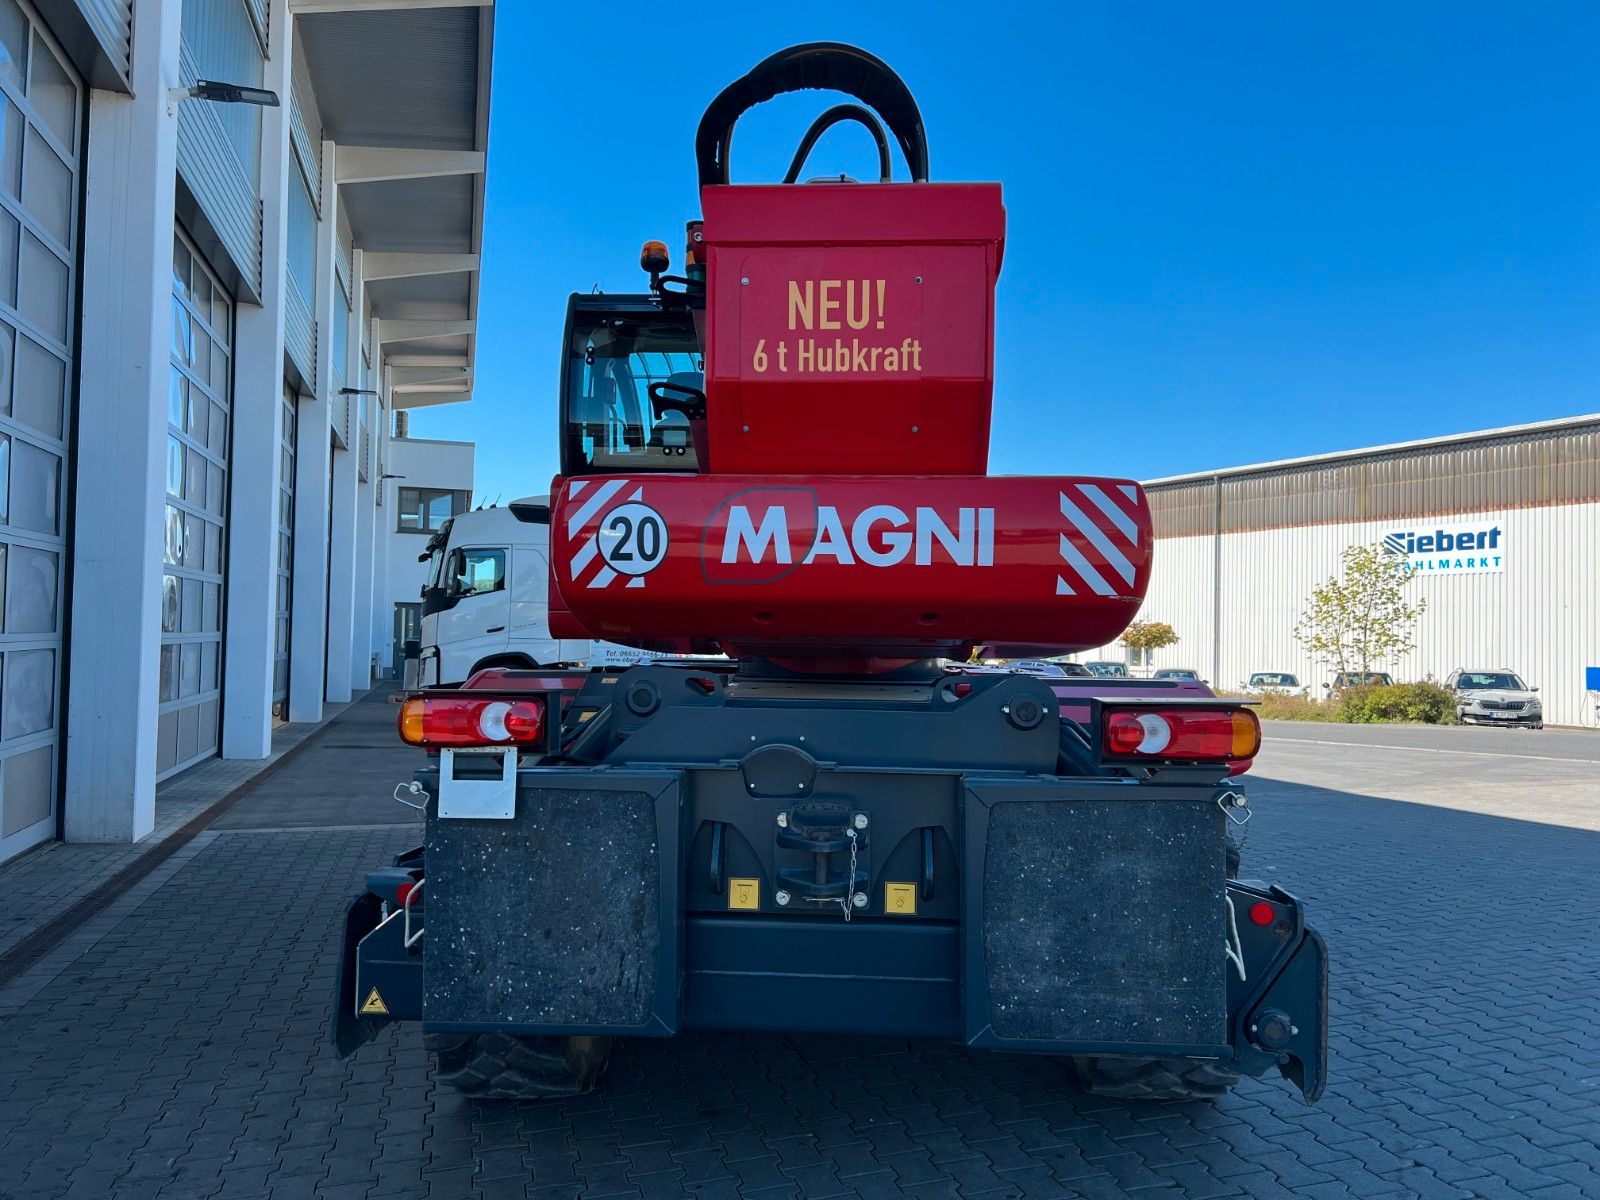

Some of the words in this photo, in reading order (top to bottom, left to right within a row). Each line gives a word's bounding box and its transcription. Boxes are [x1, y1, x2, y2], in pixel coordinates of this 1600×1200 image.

[788, 279, 886, 330] NEU!
[753, 339, 768, 373] 6
[777, 341, 788, 372] t
[798, 338, 922, 372] Hubkraft
[609, 516, 661, 562] 20
[720, 505, 995, 567] MAGNI
[1383, 526, 1501, 555] Siebert
[1390, 556, 1501, 572] AHLMARKT
